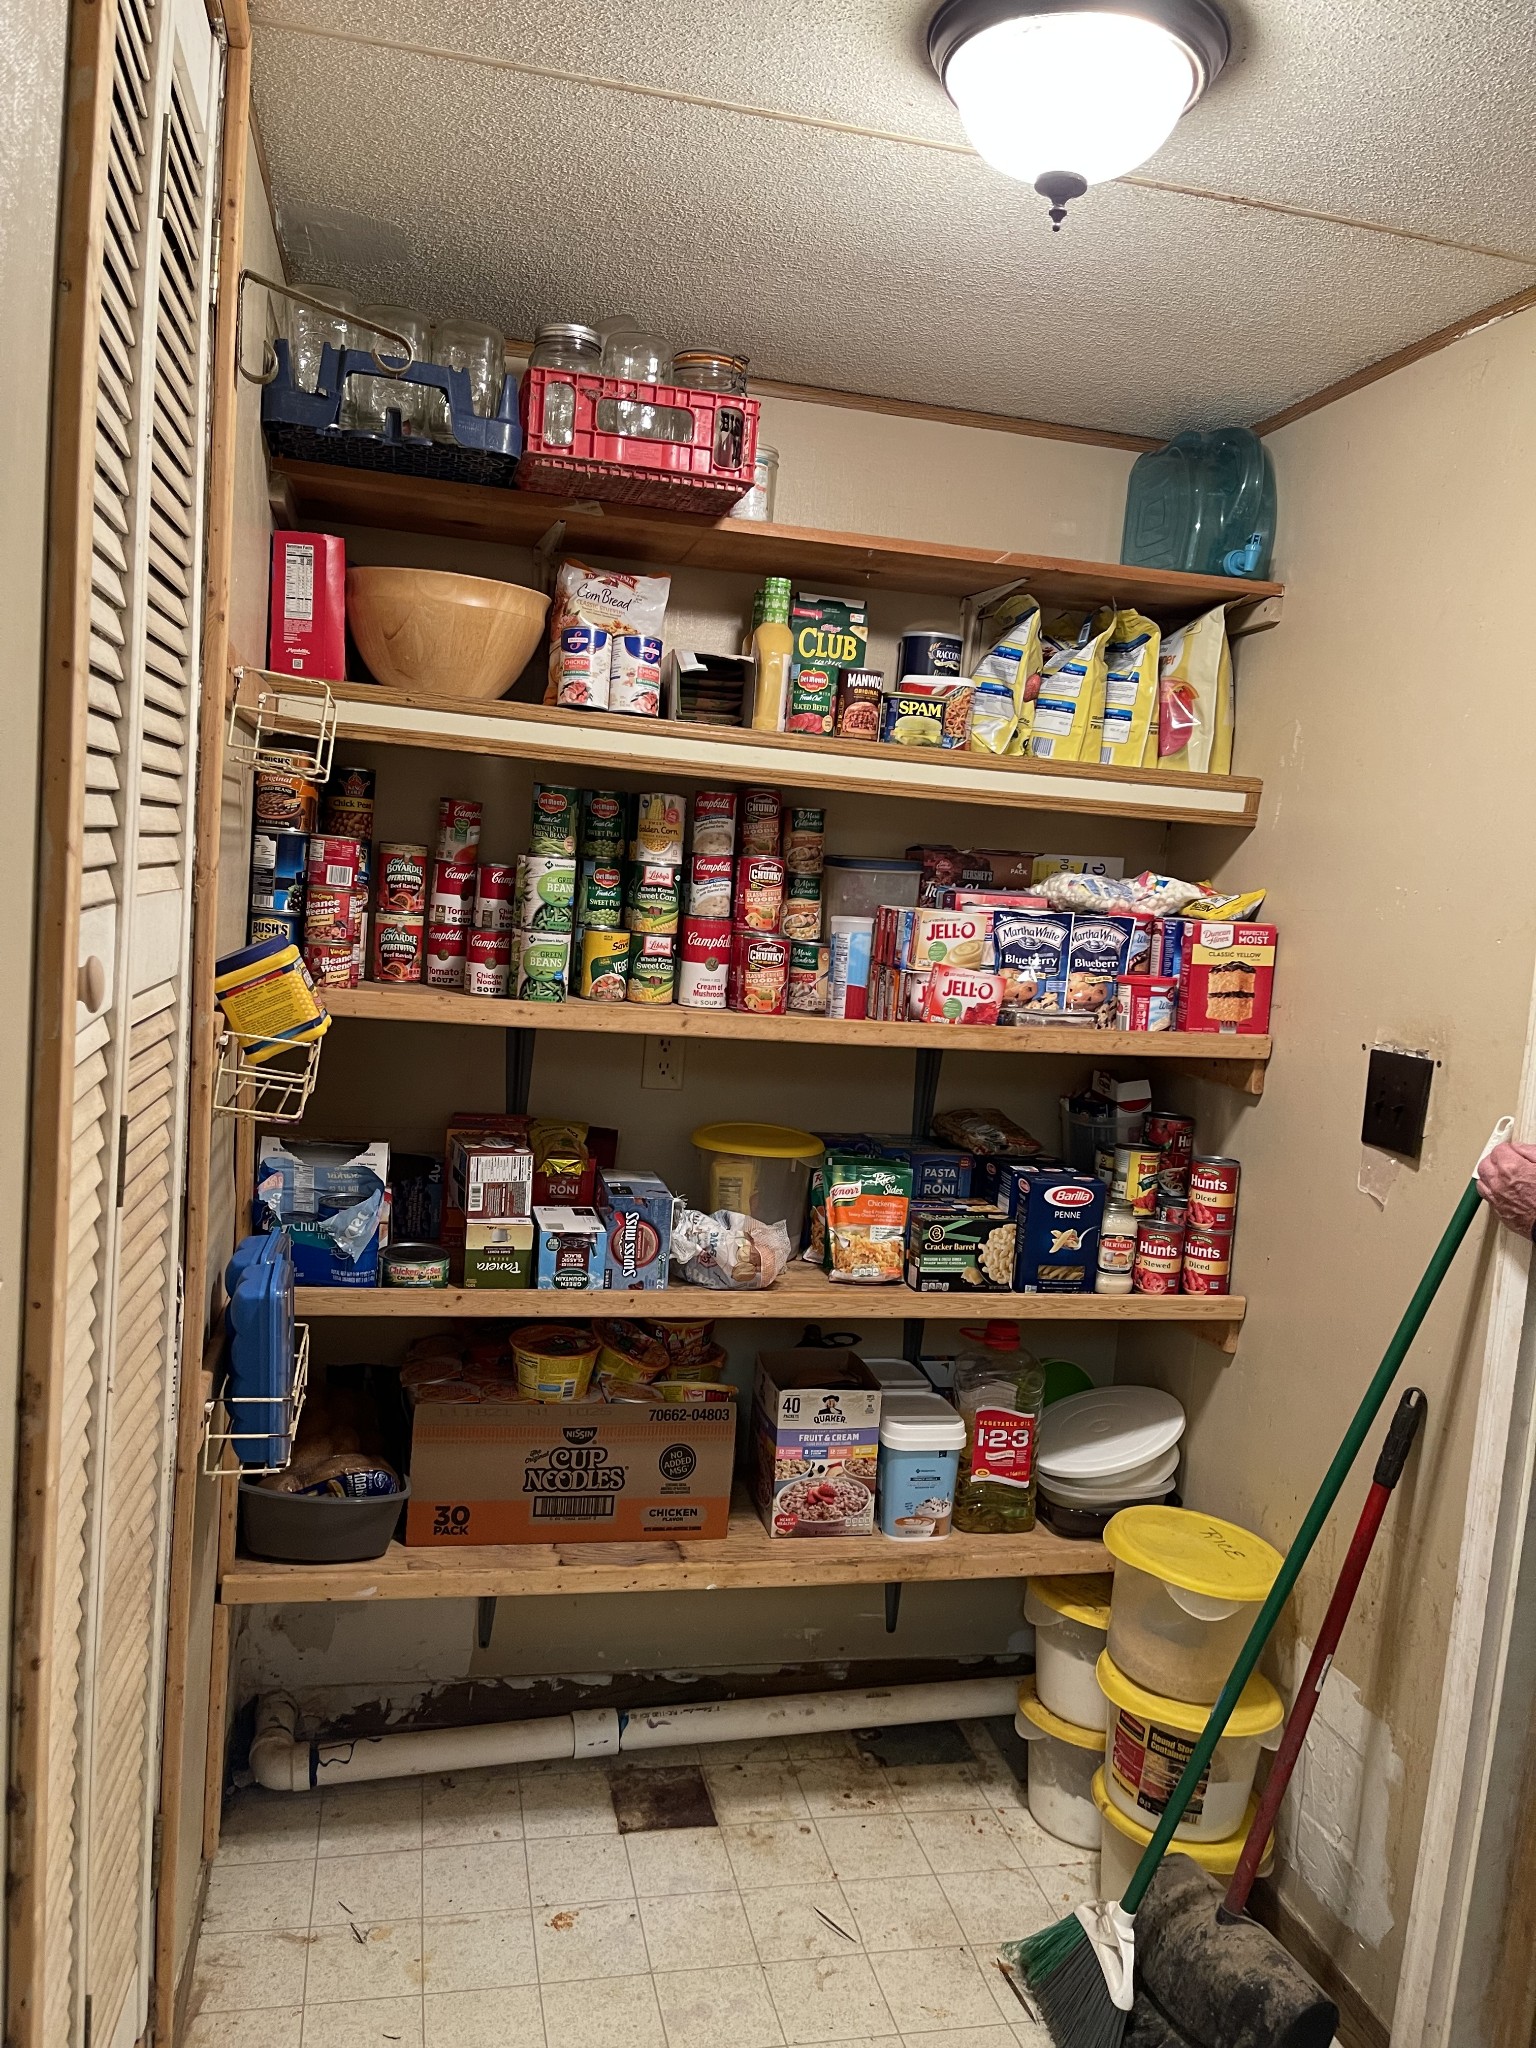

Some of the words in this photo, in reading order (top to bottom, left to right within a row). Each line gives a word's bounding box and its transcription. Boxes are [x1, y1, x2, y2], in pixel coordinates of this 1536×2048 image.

[577, 583, 600, 600] Corn
[601, 588, 633, 611] Bread
[798, 627, 857, 661] CLUB
[847, 673, 883, 689] MANWIC
[793, 702, 811, 710] SLICED
[812, 703, 829, 712] BEETS
[898, 700, 943, 717] SPAM
[261, 774, 294, 784] Original
[274, 786, 292, 794] BEANS
[333, 799, 355, 808] Chick
[357, 800, 372, 810] Peas
[747, 802, 778, 814] CHUNKY
[549, 830, 567, 839] BEANS
[661, 826, 678, 836] Corn
[386, 863, 423, 876] BOYARDEE
[696, 859, 731, 874] Campbell's
[649, 870, 669, 880] Libby's
[751, 869, 782, 881] CHUNKY
[962, 869, 993, 881] HERSHEY'S
[589, 898, 609, 906] SWEET
[637, 892, 658, 900] Sweet
[659, 893, 677, 902] Corn
[306, 899, 341, 909] Beanee
[306, 907, 341, 917] Weenee
[451, 916, 471, 924] SOUP
[252, 922, 289, 937] BUSH'S
[1003, 926, 1035, 941] Martha
[1035, 926, 1060, 941] White
[1203, 929, 1231, 939] Duncan
[380, 932, 418, 945] BOYARDEE
[1208, 936, 1230, 944] Hines
[1238, 936, 1270, 945] MOIST
[648, 940, 669, 951] Libby's
[750, 950, 784, 962] CHUNKY
[1005, 953, 1058, 967] Blueberry
[530, 957, 562, 968] BEANS
[636, 962, 659, 970] Sweet
[428, 966, 459, 976] Tomato
[476, 972, 503, 980] Chicken
[431, 976, 454, 984] SOUP
[696, 982, 717, 991] Cream
[717, 983, 723, 991] of
[692, 989, 724, 998] Mushroom
[924, 1168, 957, 1178] PASTA
[549, 1184, 579, 1195] RONI
[831, 1186, 860, 1197] Knorr
[883, 1184, 904, 1195] Sides
[923, 1184, 955, 1195] RONI
[1056, 1190, 1090, 1202] Barilla
[1195, 1193, 1217, 1203] Diced
[867, 1200, 891, 1208] Chicken
[1054, 1211, 1082, 1219] PENNE
[924, 1243, 953, 1251] Cracker
[953, 1243, 976, 1251] Barrel
[1104, 1241, 1133, 1249] BERTOLLI
[622, 1243, 637, 1277] SWISS
[1143, 1260, 1171, 1269] Stewed
[1188, 1260, 1210, 1271] Diced
[476, 1261, 521, 1274] Panera
[782, 1397, 800, 1413] 40
[648, 1409, 731, 1422] 70662-04803
[813, 1415, 846, 1424] QUAKER
[566, 1429, 594, 1440] NISSIN
[799, 1434, 824, 1442] FRUIT
[832, 1433, 860, 1441] CREAM
[524, 1450, 550, 1464] Original
[549, 1447, 608, 1470] CUP
[670, 1451, 683, 1459] NO
[664, 1457, 692, 1469] ADDED
[669, 1466, 688, 1476] MSG
[524, 1467, 625, 1492] NOODLES
[433, 1505, 471, 1526] 30
[649, 1508, 698, 1517] CHICKEN
[433, 1525, 469, 1536] PACK
[1199, 1526, 1246, 1561] RICE
[1152, 1733, 1176, 1749] Round
[1177, 1743, 1194, 1754] Stor
